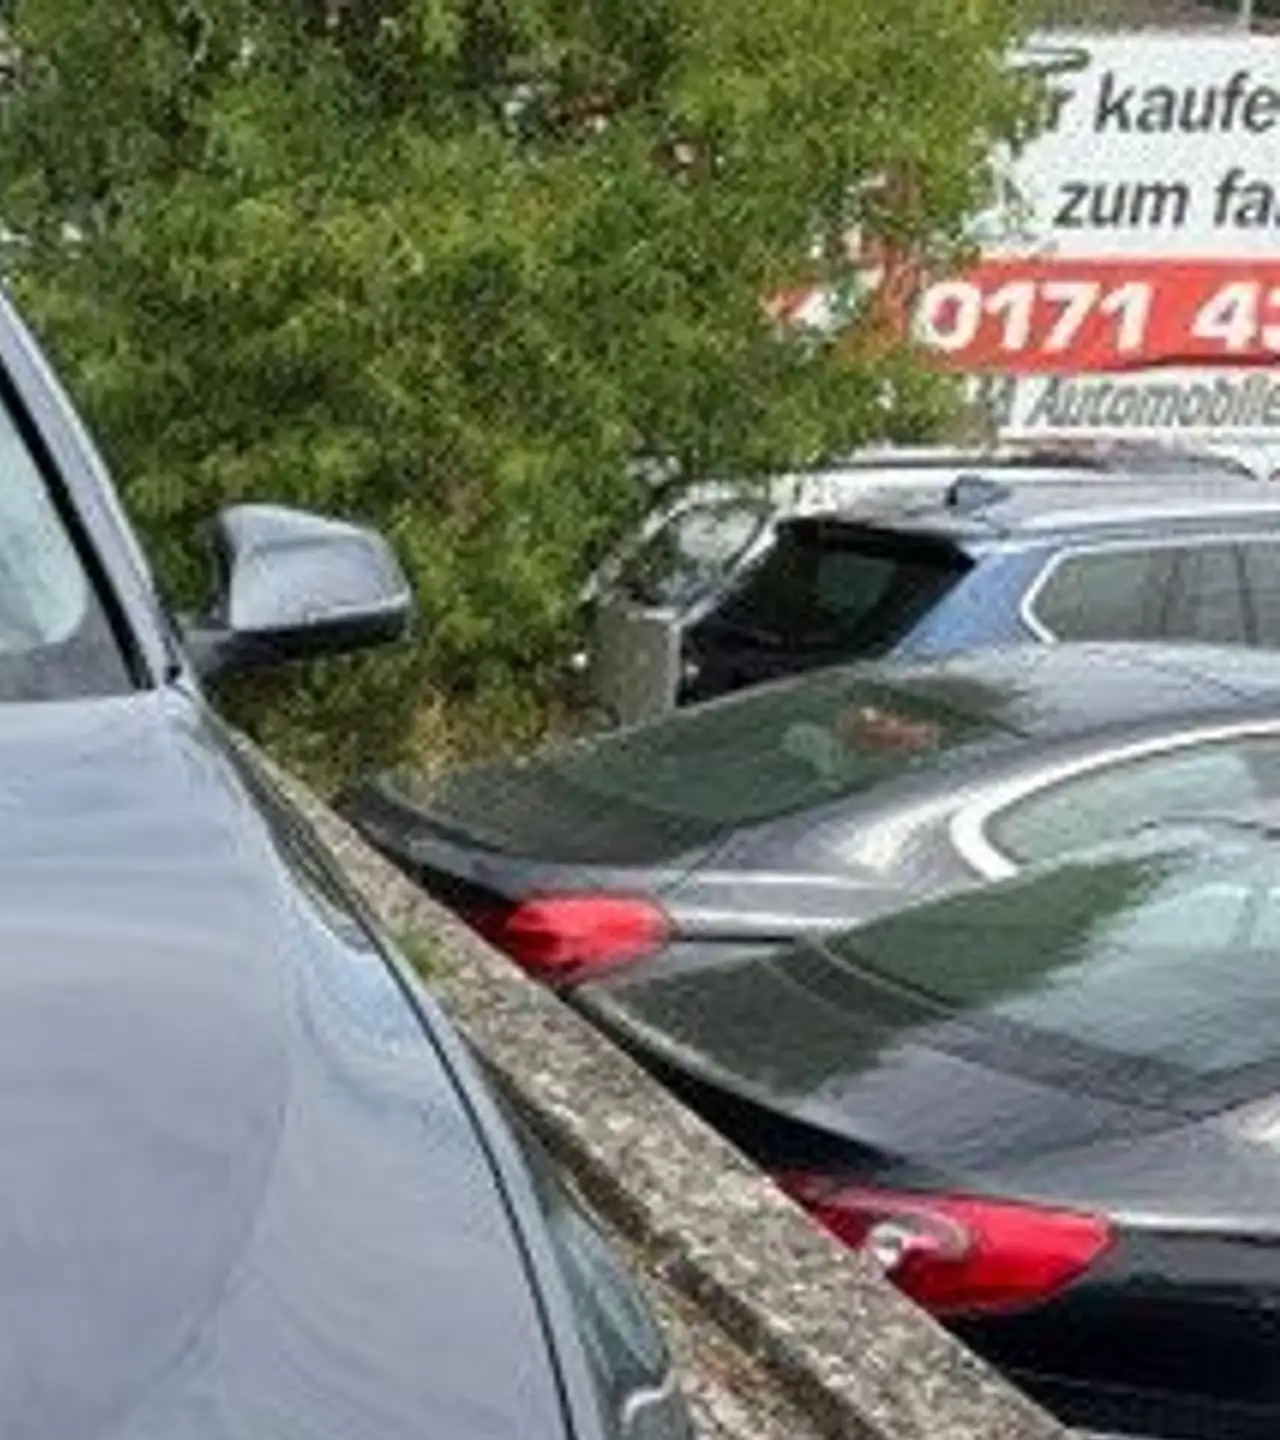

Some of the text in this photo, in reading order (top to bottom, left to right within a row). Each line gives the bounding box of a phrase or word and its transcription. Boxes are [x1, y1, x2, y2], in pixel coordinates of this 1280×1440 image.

[1052, 166, 1280, 230] zum fa
[914, 280, 1153, 350] 0171
